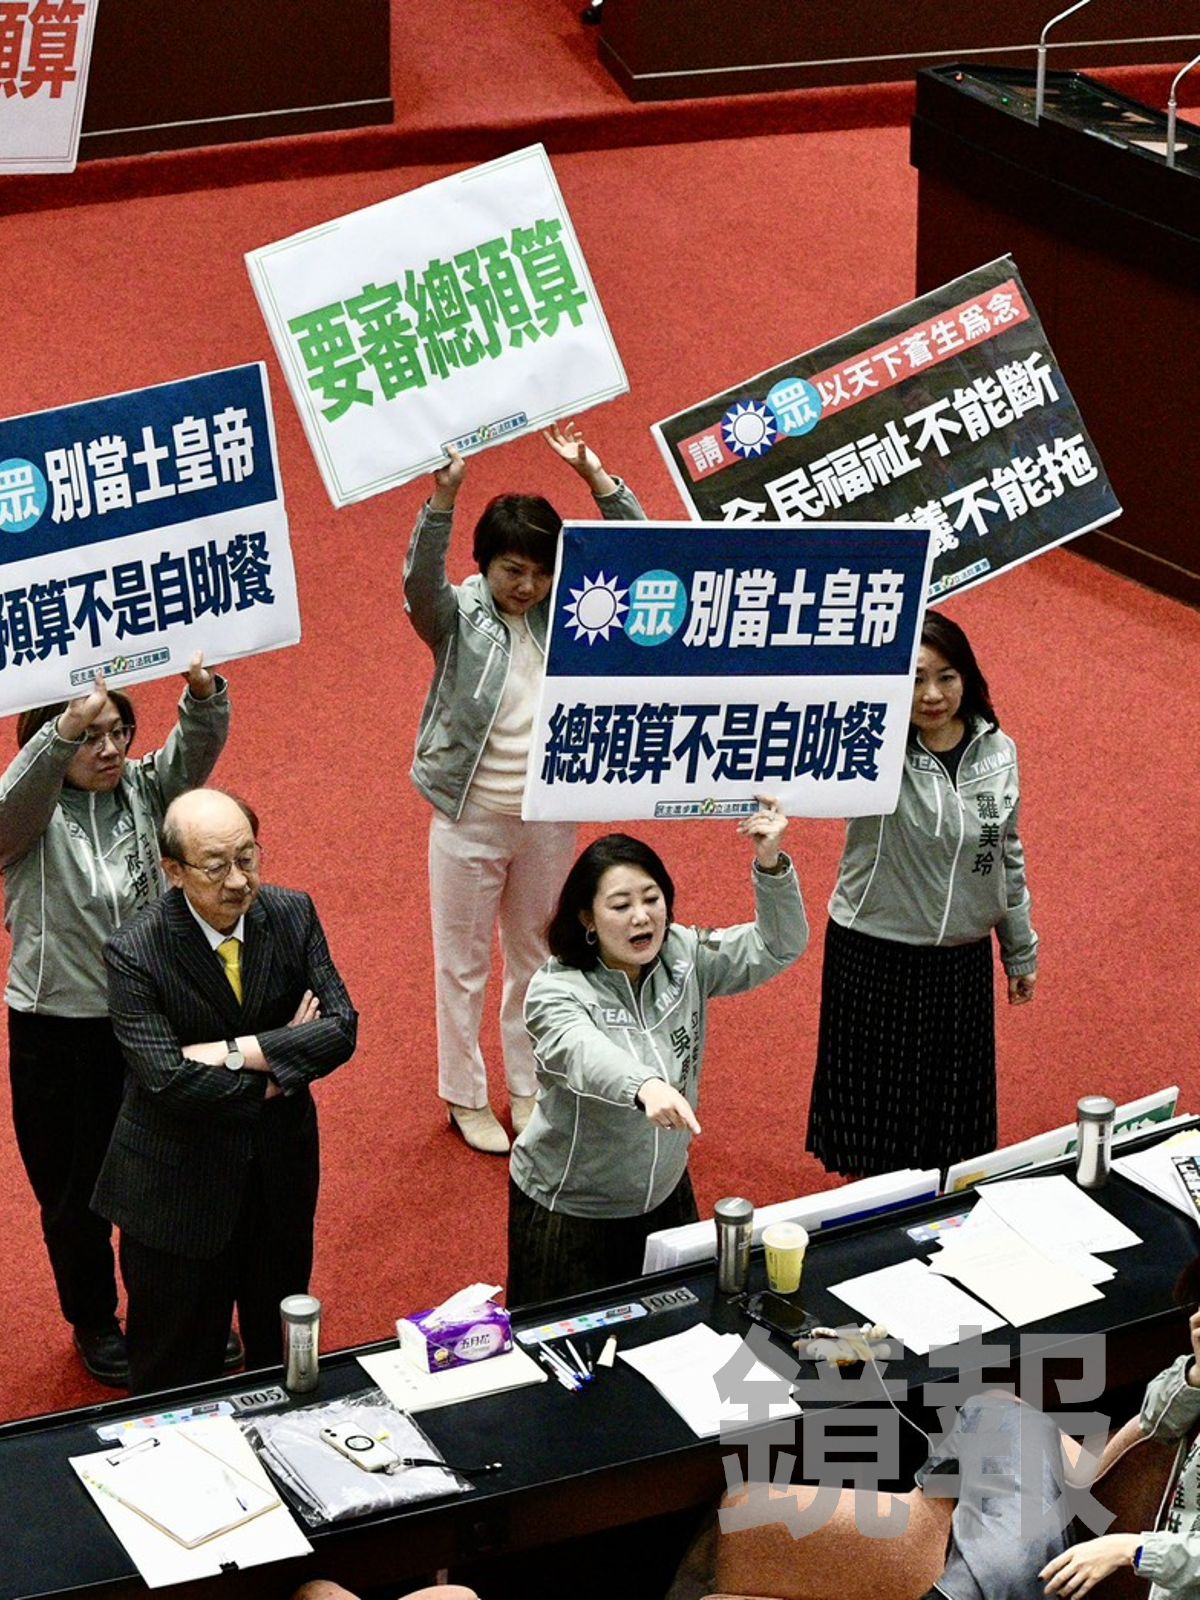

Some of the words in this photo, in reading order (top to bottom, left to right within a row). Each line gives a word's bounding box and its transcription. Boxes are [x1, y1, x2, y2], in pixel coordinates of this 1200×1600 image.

[287, 218, 588, 423] 要審總預算
[541, 701, 887, 785] 總預算不是自助餐
[972, 794, 1000, 877] 羅美玲
[650, 1291, 690, 1307] 006
[241, 1390, 282, 1406] 005
